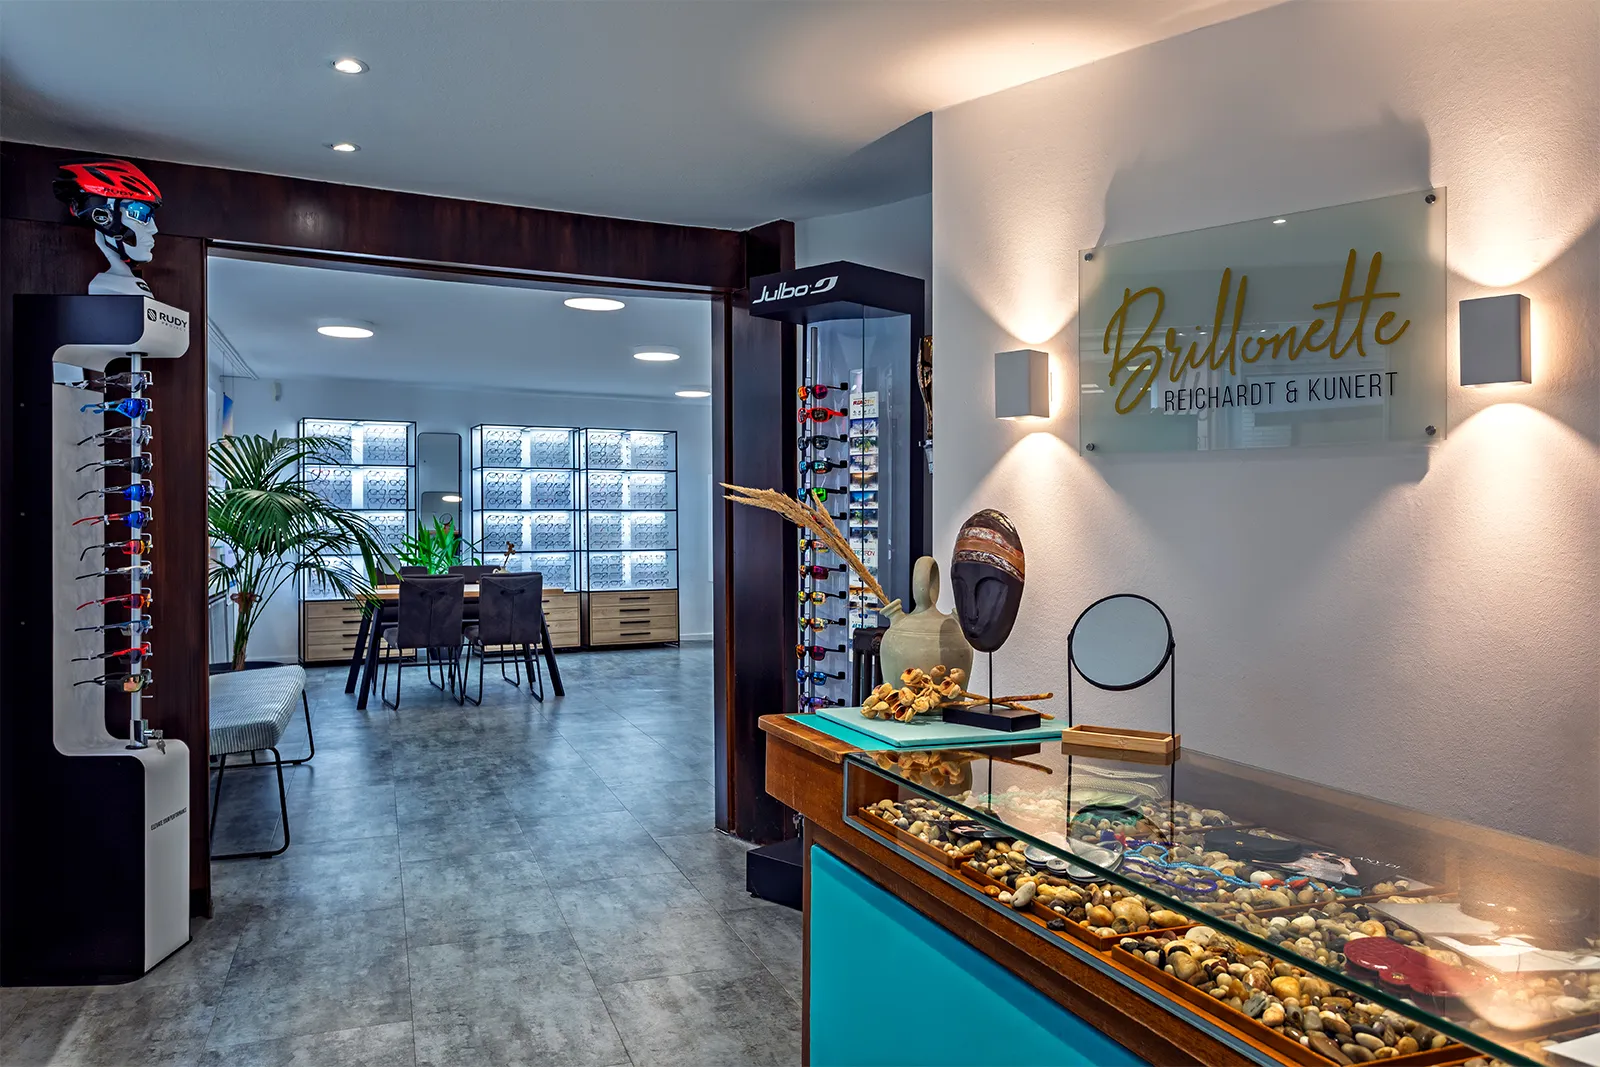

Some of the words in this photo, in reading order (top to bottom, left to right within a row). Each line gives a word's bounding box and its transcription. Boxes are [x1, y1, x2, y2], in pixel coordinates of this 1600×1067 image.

[752, 282, 809, 304] Julbo
[159, 311, 188, 328] RUDY
[1103, 248, 1411, 415] Brillonette
[1164, 381, 1276, 411] REICHARDT
[1286, 380, 1298, 403] &
[1308, 371, 1398, 402] KUNERT
